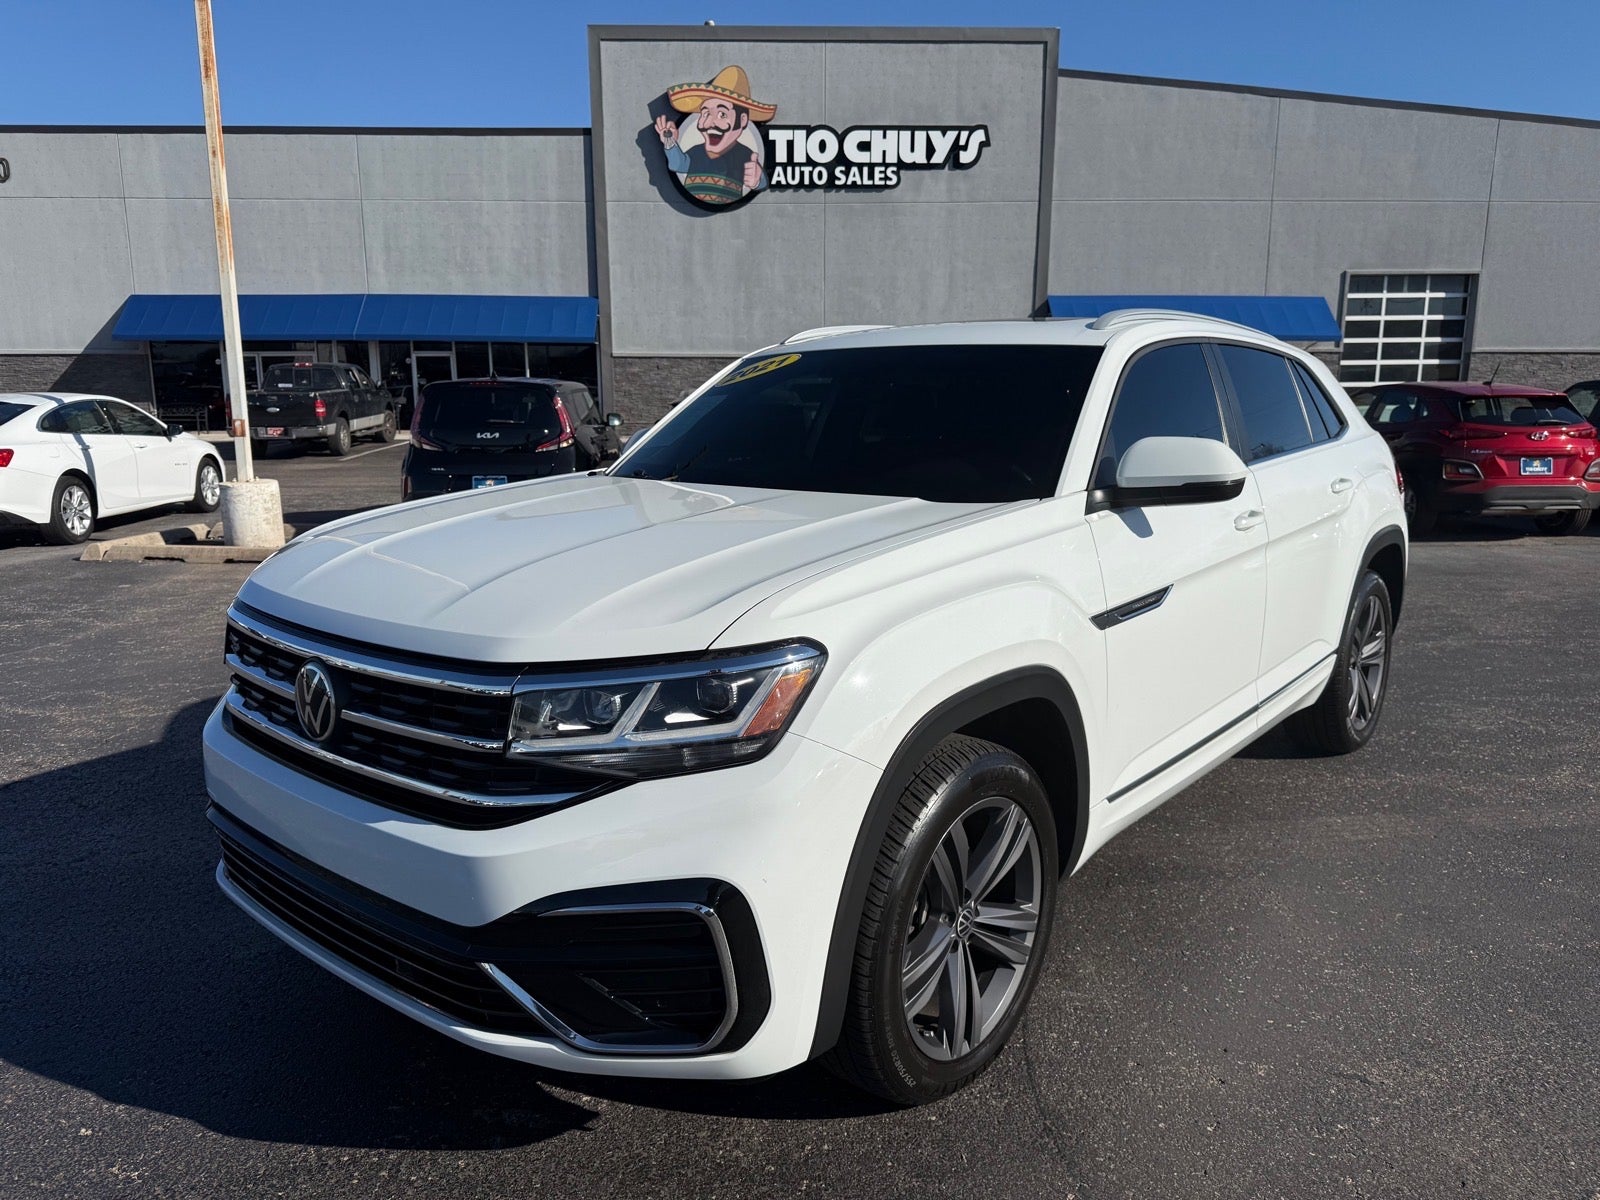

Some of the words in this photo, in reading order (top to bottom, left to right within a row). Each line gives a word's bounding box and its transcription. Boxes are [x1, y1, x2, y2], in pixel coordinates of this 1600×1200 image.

[768, 129, 839, 164] TIO
[843, 127, 987, 165] CHUY'S
[771, 166, 828, 186] AUTO
[834, 166, 898, 186] SALES
